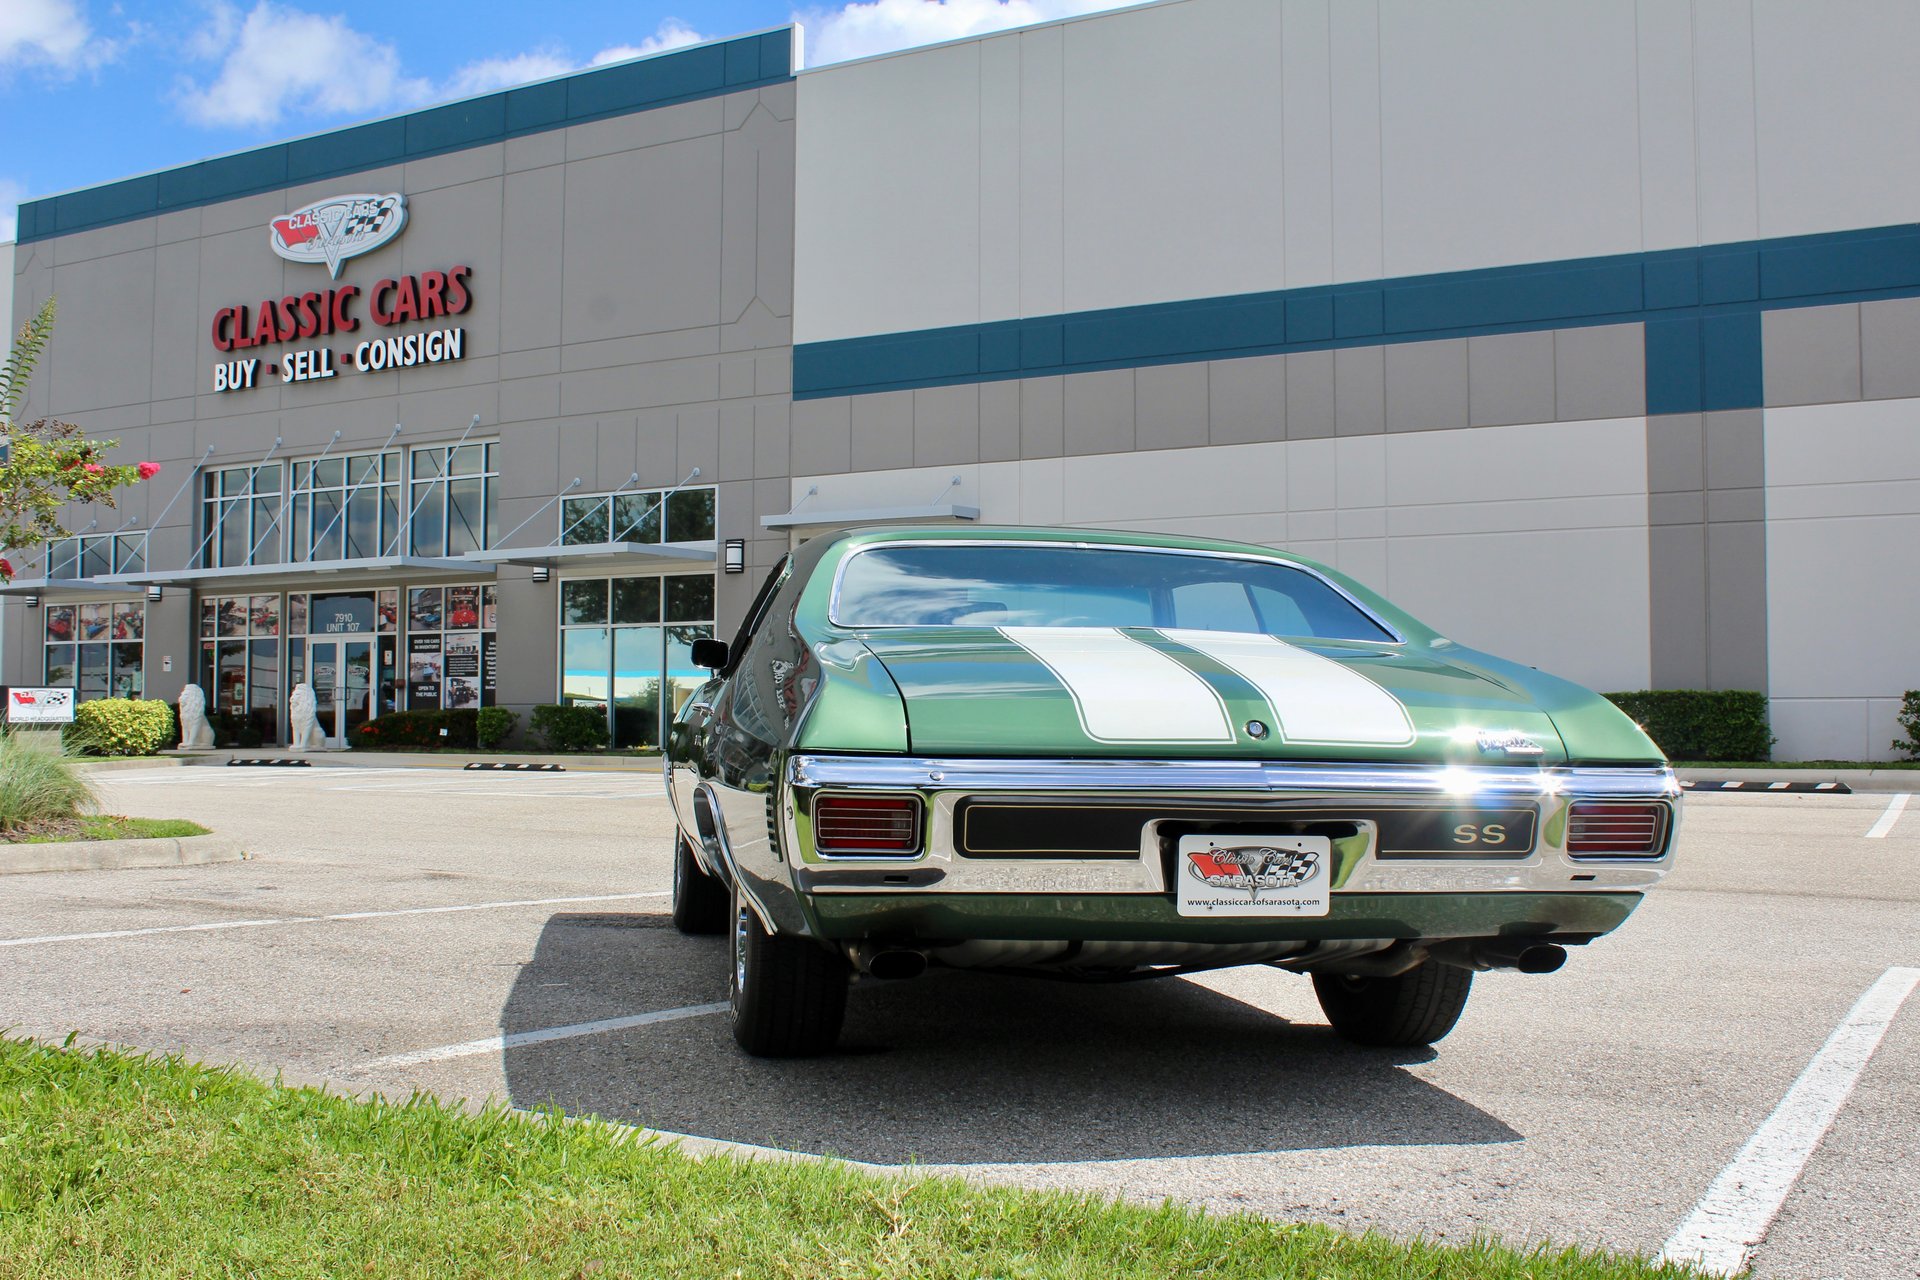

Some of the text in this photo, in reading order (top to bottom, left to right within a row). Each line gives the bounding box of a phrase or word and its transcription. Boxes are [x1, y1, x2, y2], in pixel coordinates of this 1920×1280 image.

[288, 201, 379, 230] CLASSIC CARS
[212, 265, 471, 351] CLASSIC CARS
[214, 328, 463, 392] BUY SELL CONSIGN
[326, 622, 361, 633] UNIT 107
[335, 613, 353, 623] 7910
[1453, 824, 1506, 844] SS
[1209, 847, 1297, 866] Classic Cars
[1209, 874, 1299, 888] SARASOTA
[1187, 898, 1320, 907] www.classiccarsofsarasota.com
